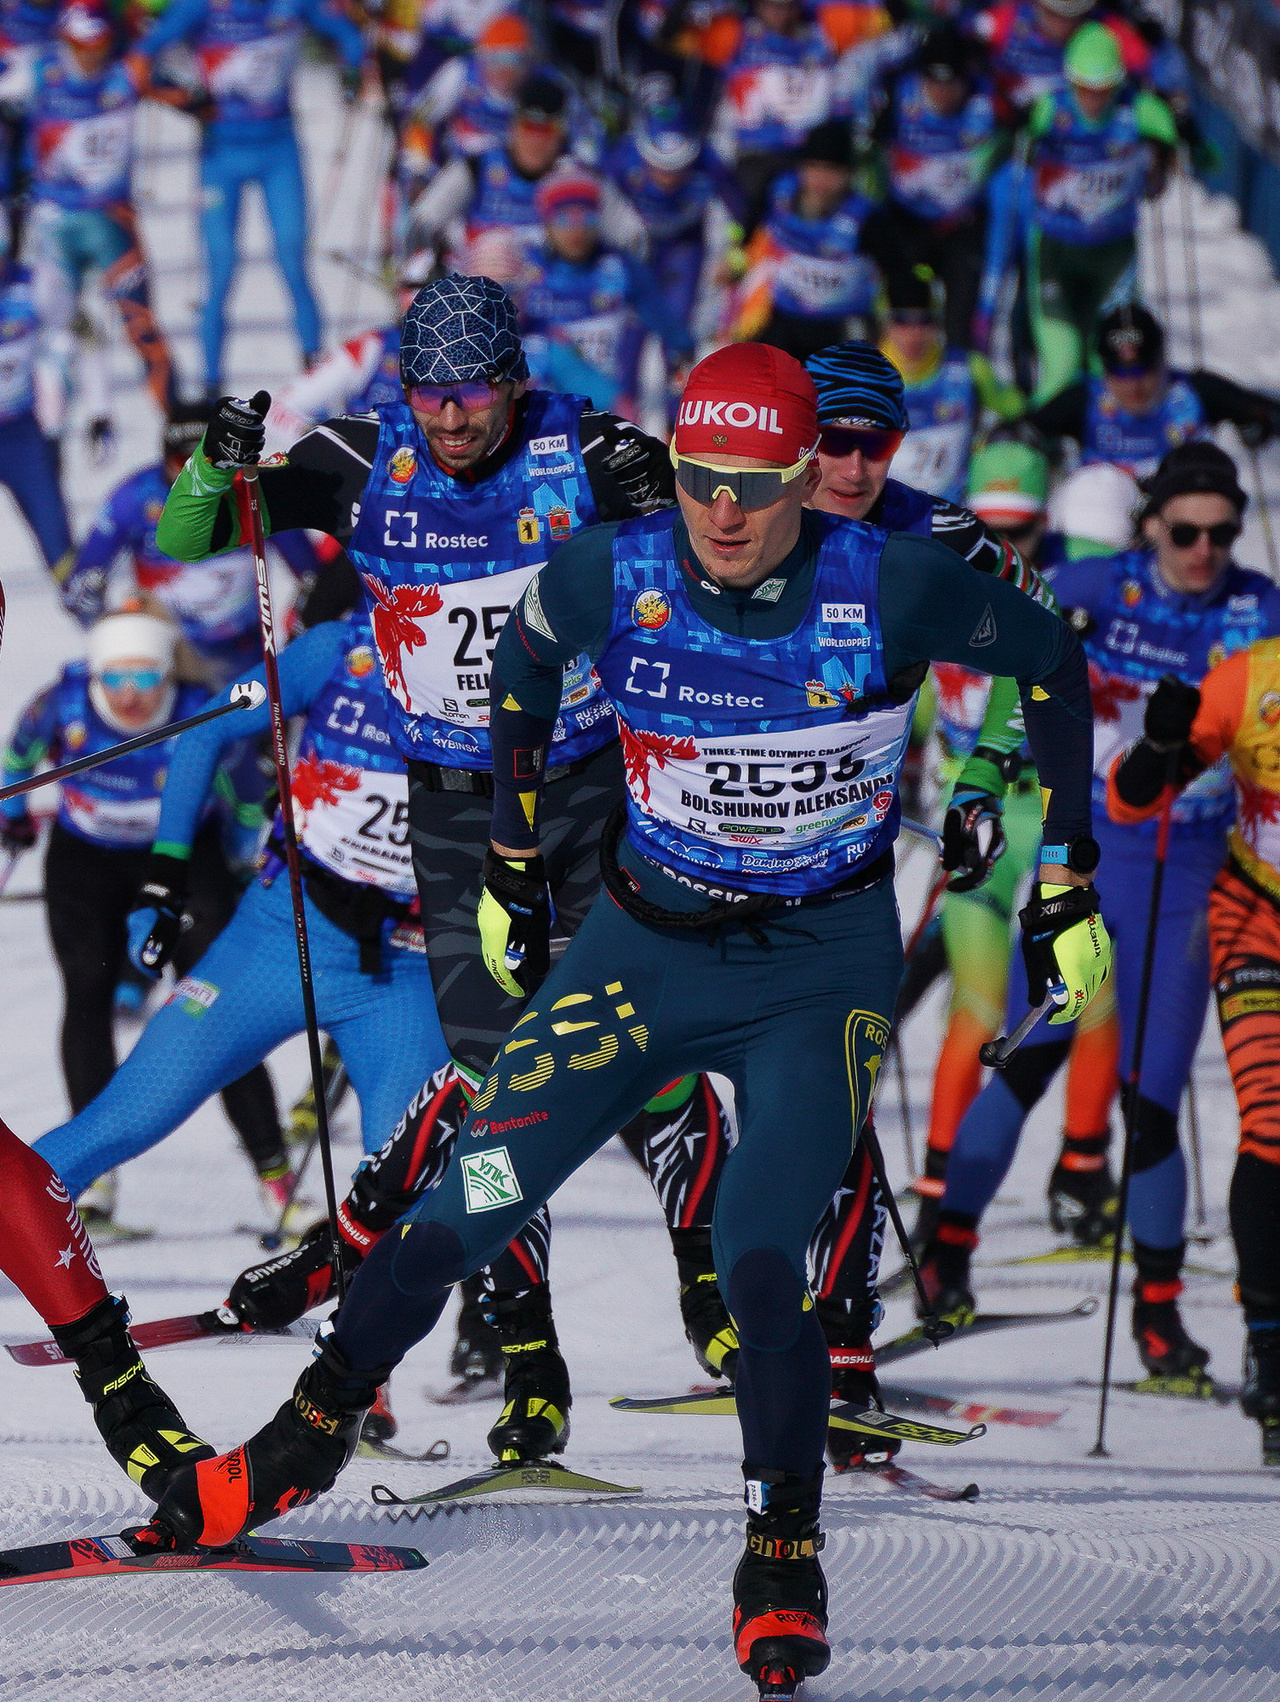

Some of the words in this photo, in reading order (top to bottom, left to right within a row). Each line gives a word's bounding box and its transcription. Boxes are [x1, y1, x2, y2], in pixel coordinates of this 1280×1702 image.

[679, 400, 784, 435] LUKOIL
[532, 441, 545, 451] 50
[549, 438, 566, 448] KM
[425, 532, 489, 549] Rostec
[826, 608, 839, 619] 50
[843, 608, 864, 619] KM
[818, 636, 872, 648] WORLDLOPPET
[678, 686, 765, 708] Rostec
[701, 747, 767, 757] THREE-TIME
[768, 747, 816, 758] OLYMPIC
[681, 789, 791, 818] BOLSHUNOV
[721, 823, 783, 833] POWERUP
[489, 1110, 549, 1135] Bentonite
